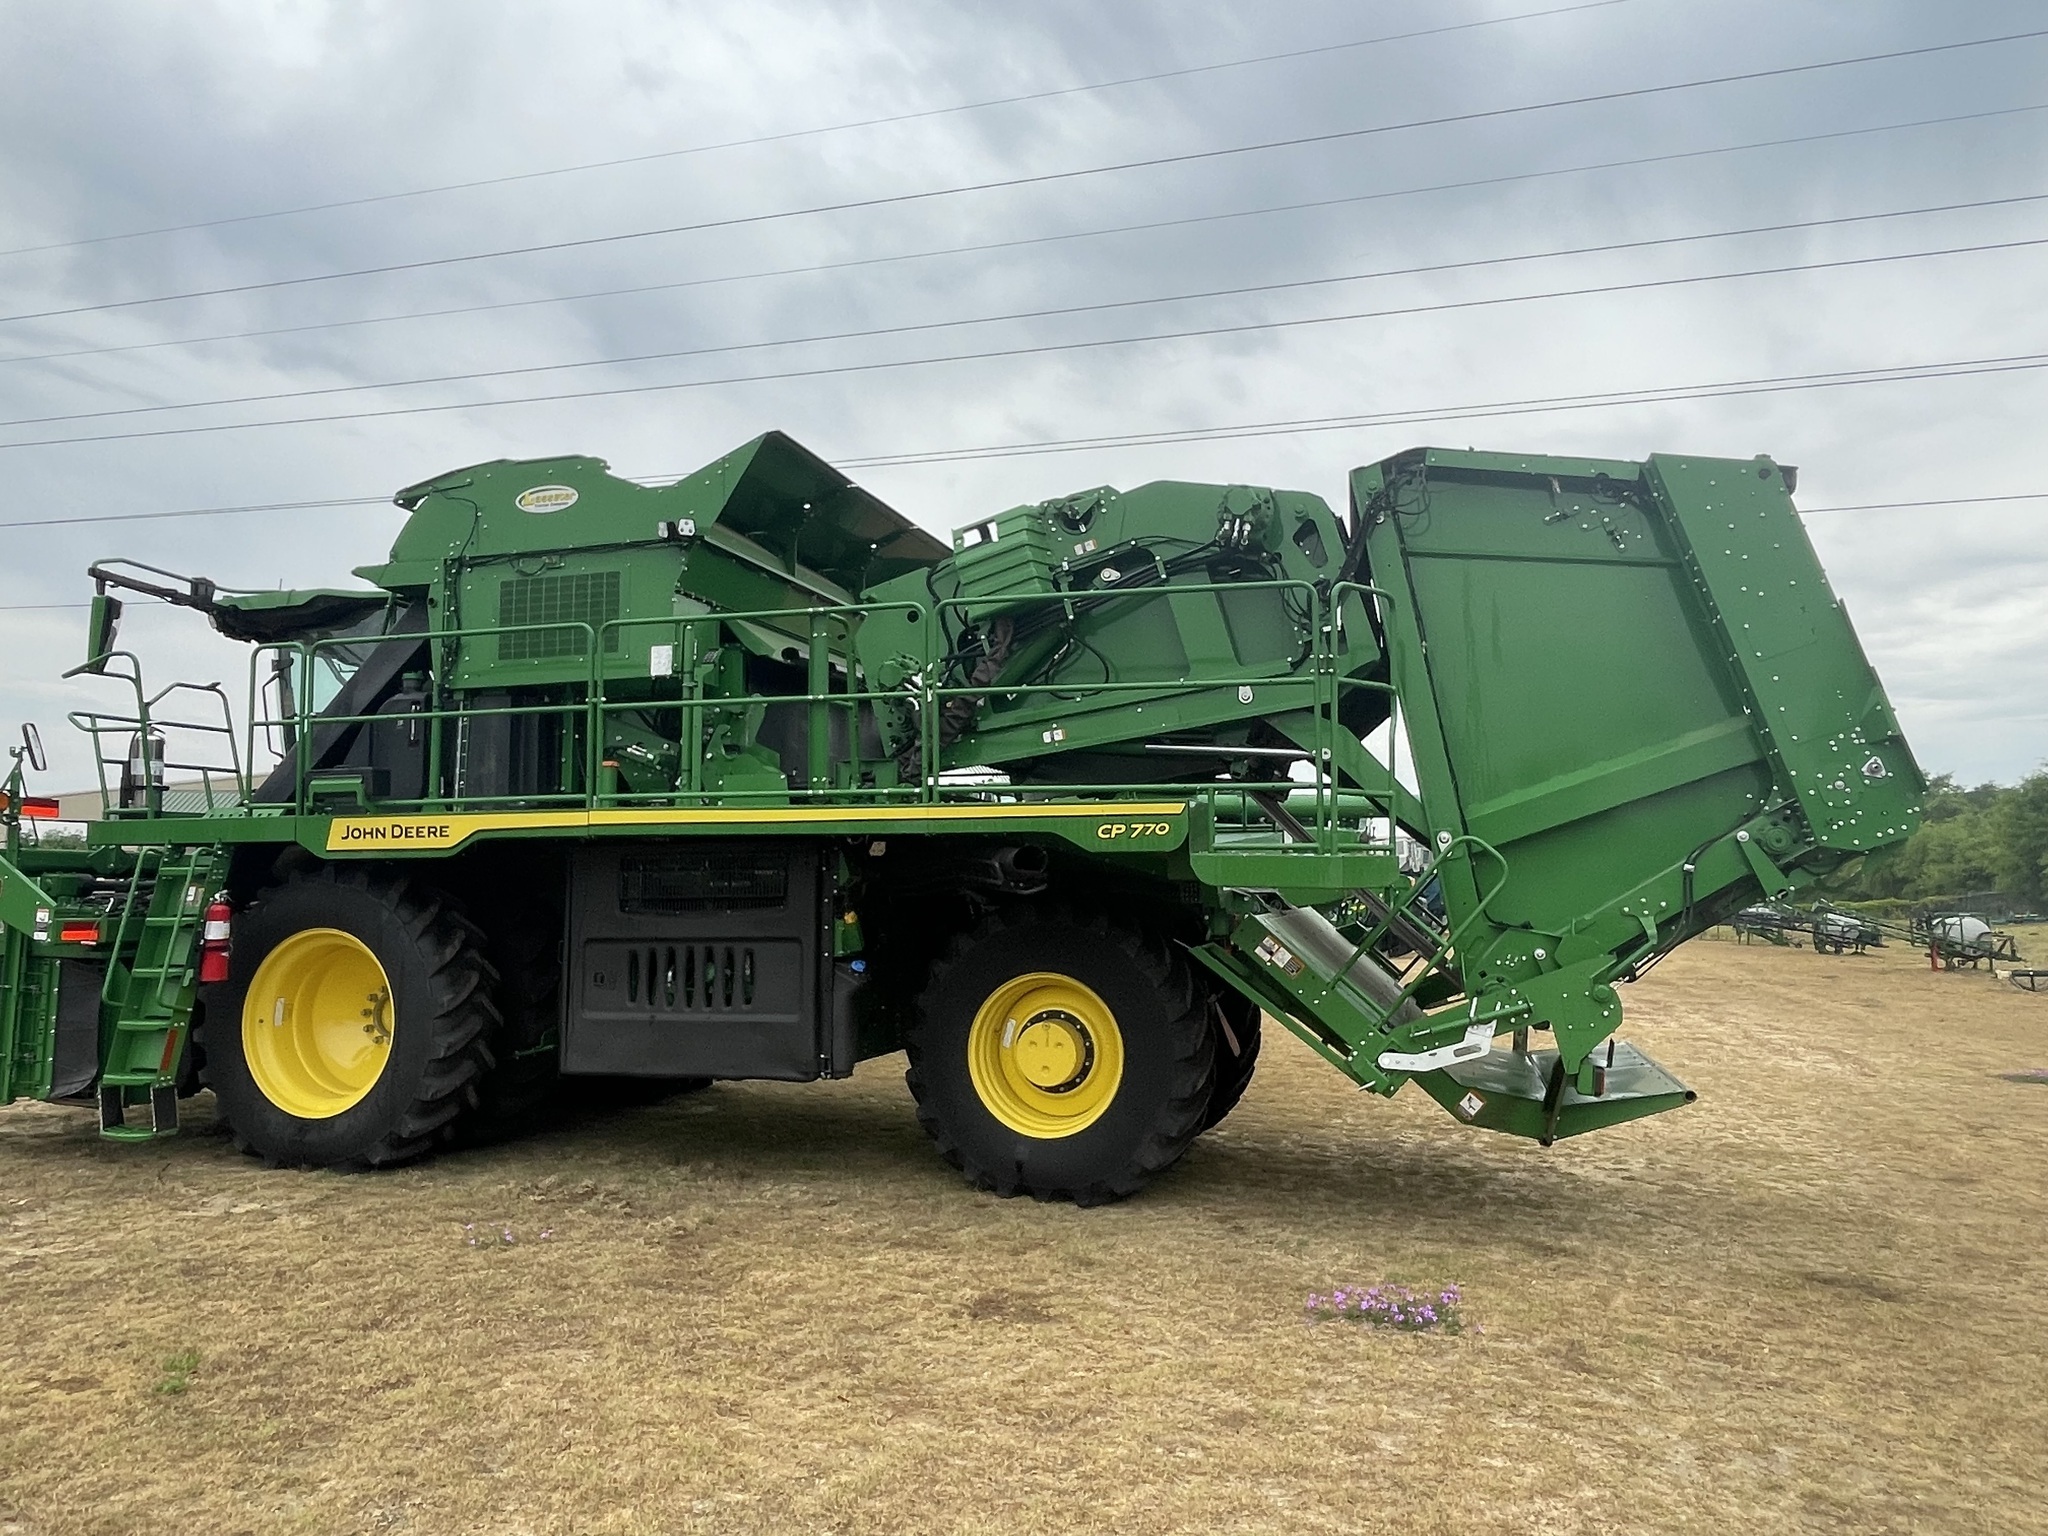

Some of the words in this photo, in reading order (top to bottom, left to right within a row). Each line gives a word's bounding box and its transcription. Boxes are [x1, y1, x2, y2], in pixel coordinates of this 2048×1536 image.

[341, 825, 386, 840] JOHN
[391, 824, 450, 839] DEERE
[1097, 823, 1127, 839] CP
[1130, 822, 1171, 838] 770
